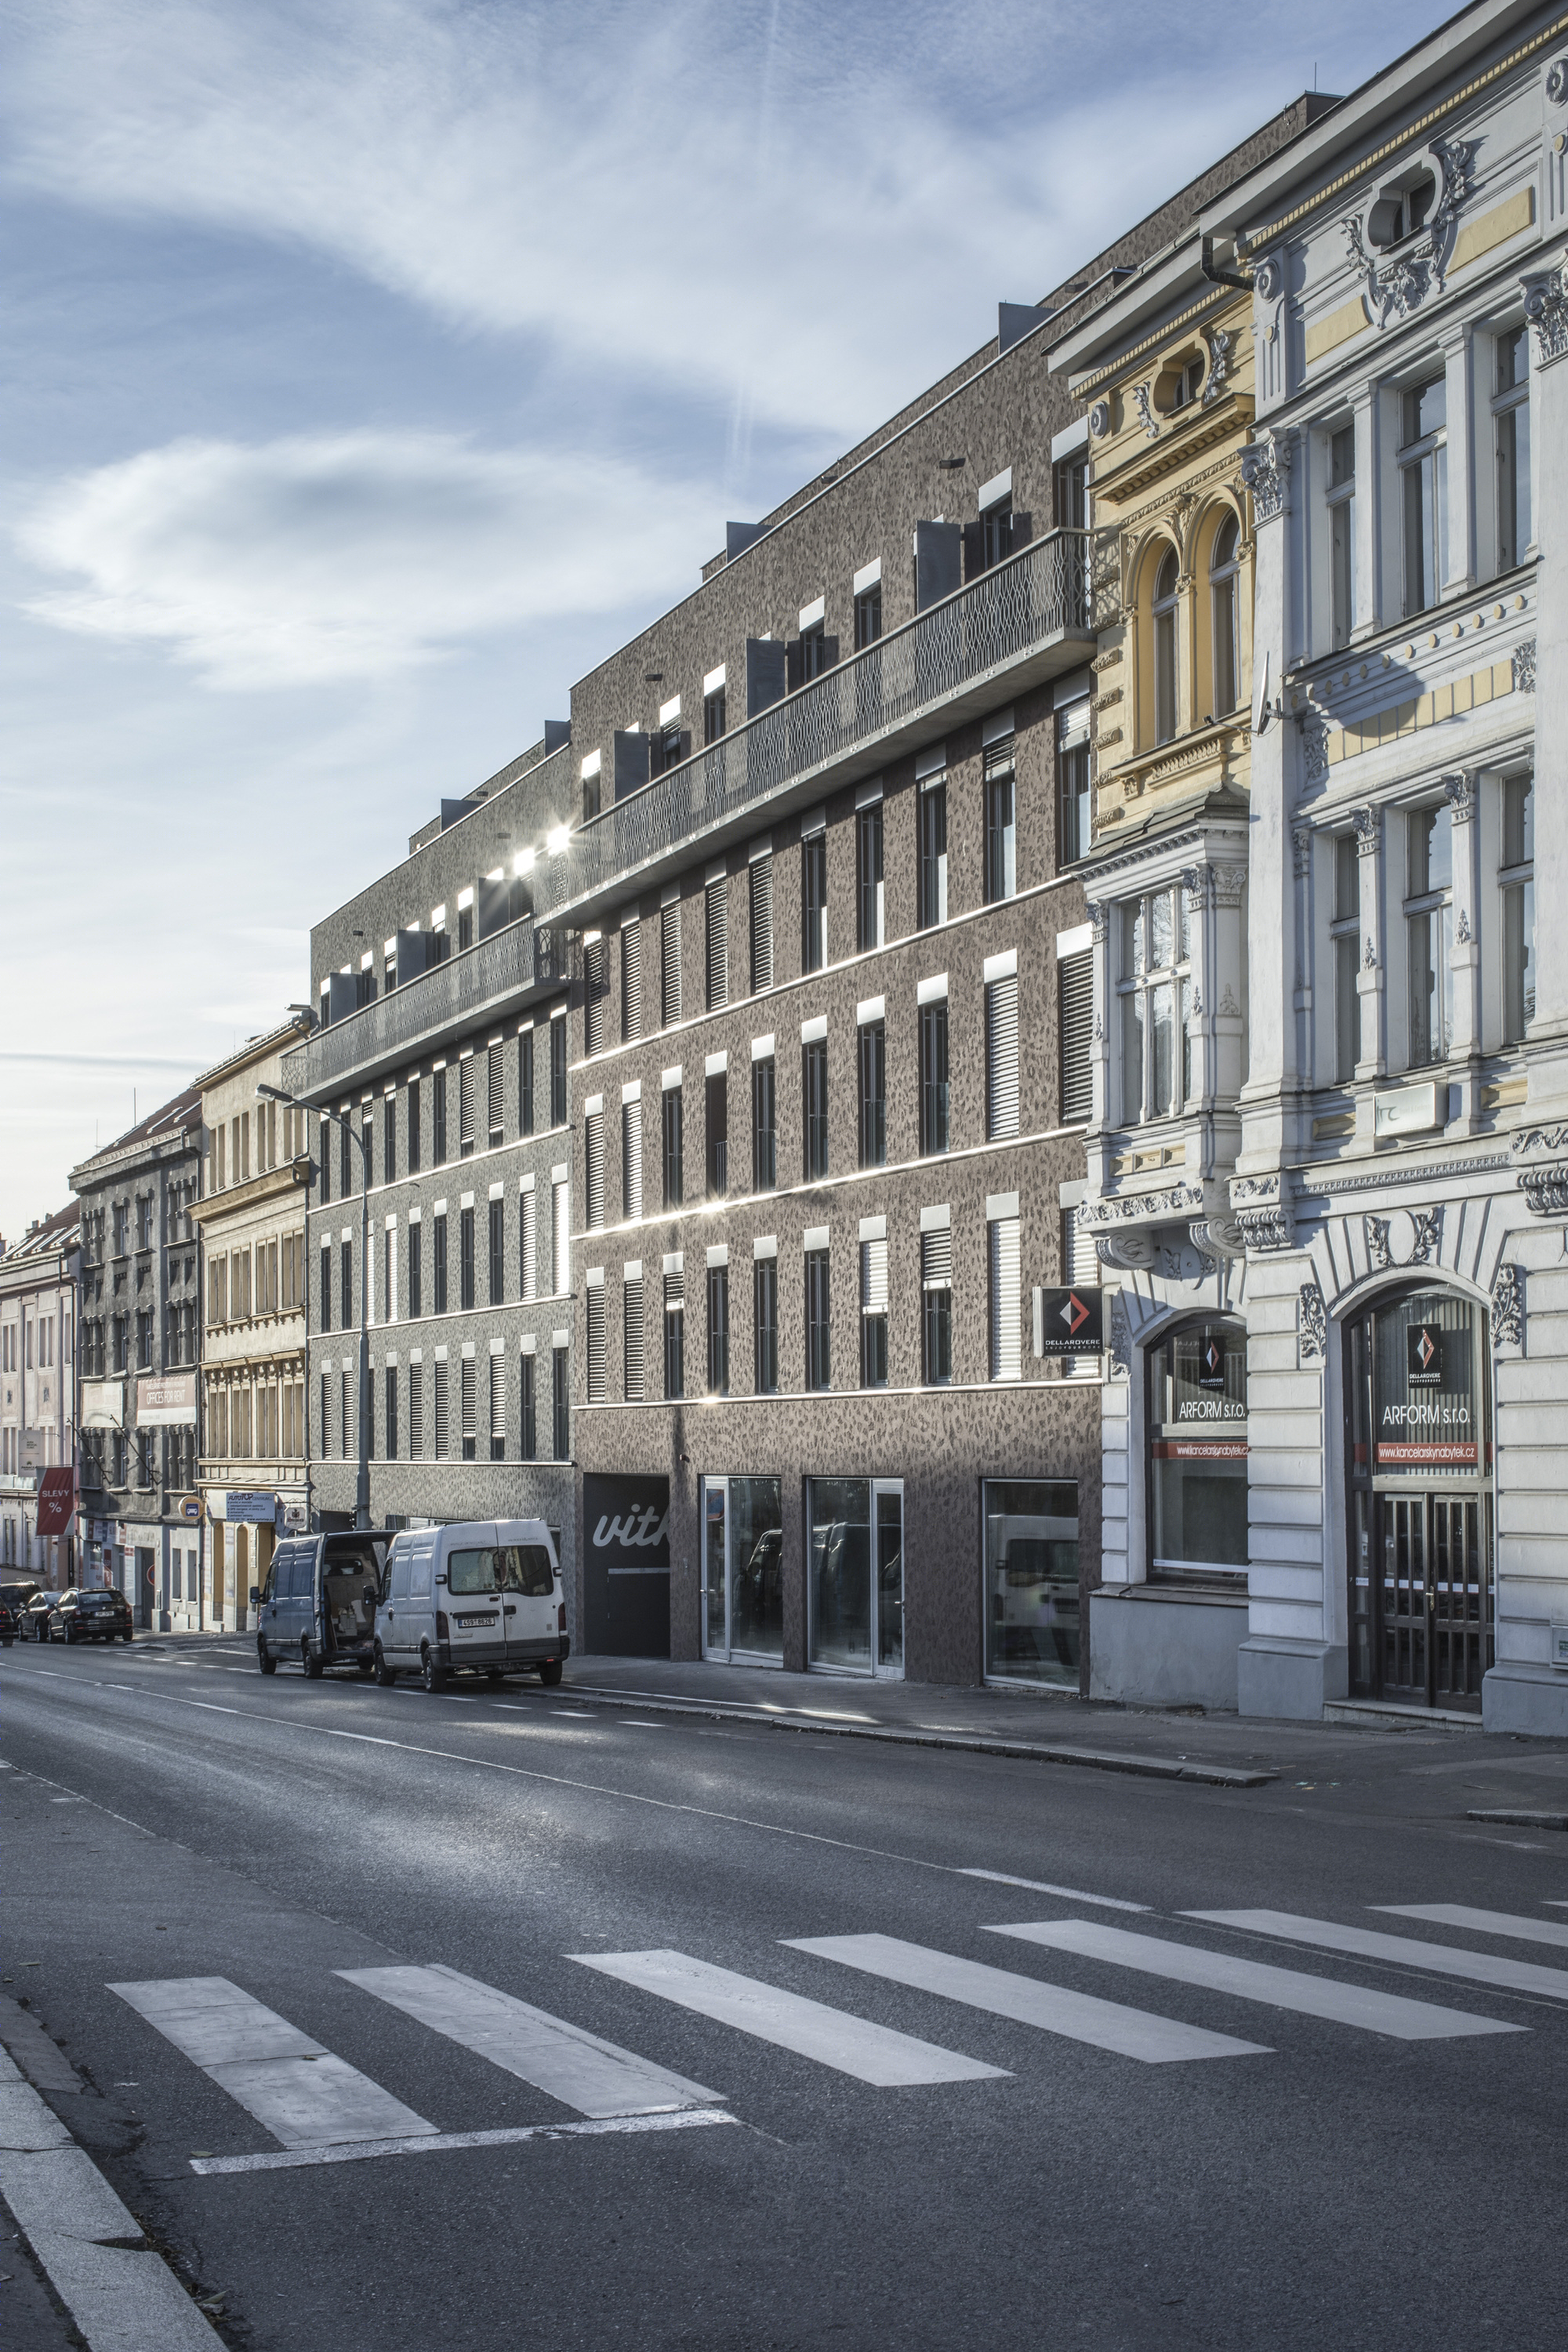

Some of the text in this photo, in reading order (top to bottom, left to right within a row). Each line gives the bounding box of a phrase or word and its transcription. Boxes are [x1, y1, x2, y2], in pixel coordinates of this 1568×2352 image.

[147, 1389, 185, 1404] OFFICES FOR RENT
[1178, 1400, 1246, 1419] ARFORM s.r.o.
[1382, 1404, 1470, 1425] ARFORM s.r.o.
[1379, 1446, 1475, 1460] www.kancelarskynabytek.cz
[49, 1501, 62, 1513] %
